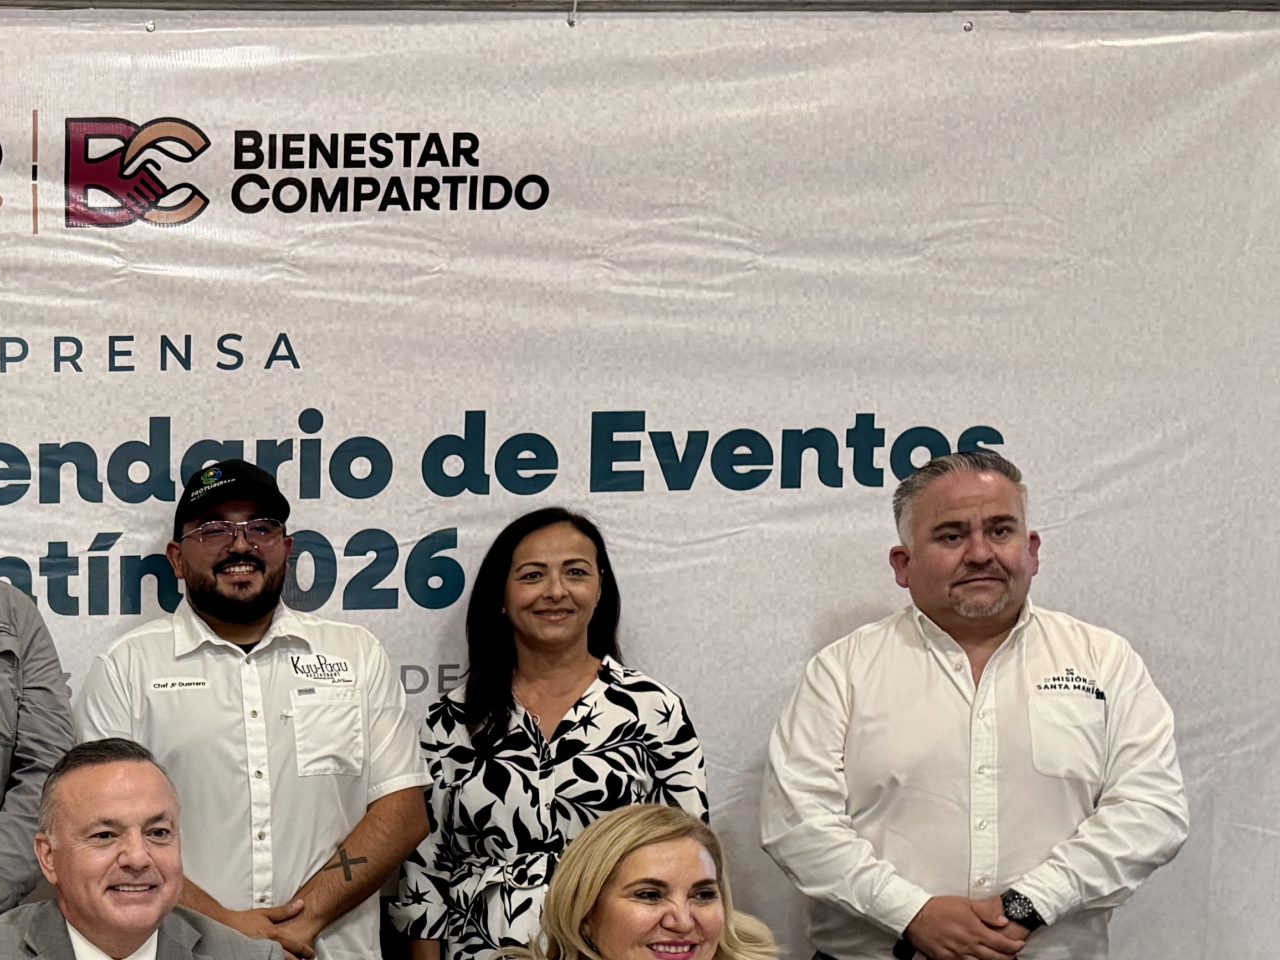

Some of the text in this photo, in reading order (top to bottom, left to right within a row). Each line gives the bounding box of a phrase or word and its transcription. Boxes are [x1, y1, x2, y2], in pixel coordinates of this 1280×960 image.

[233, 130, 480, 170] BIENESTAR
[231, 173, 550, 215] COMPARTIDO
[422, 410, 558, 497] de
[281, 527, 466, 611] 026
